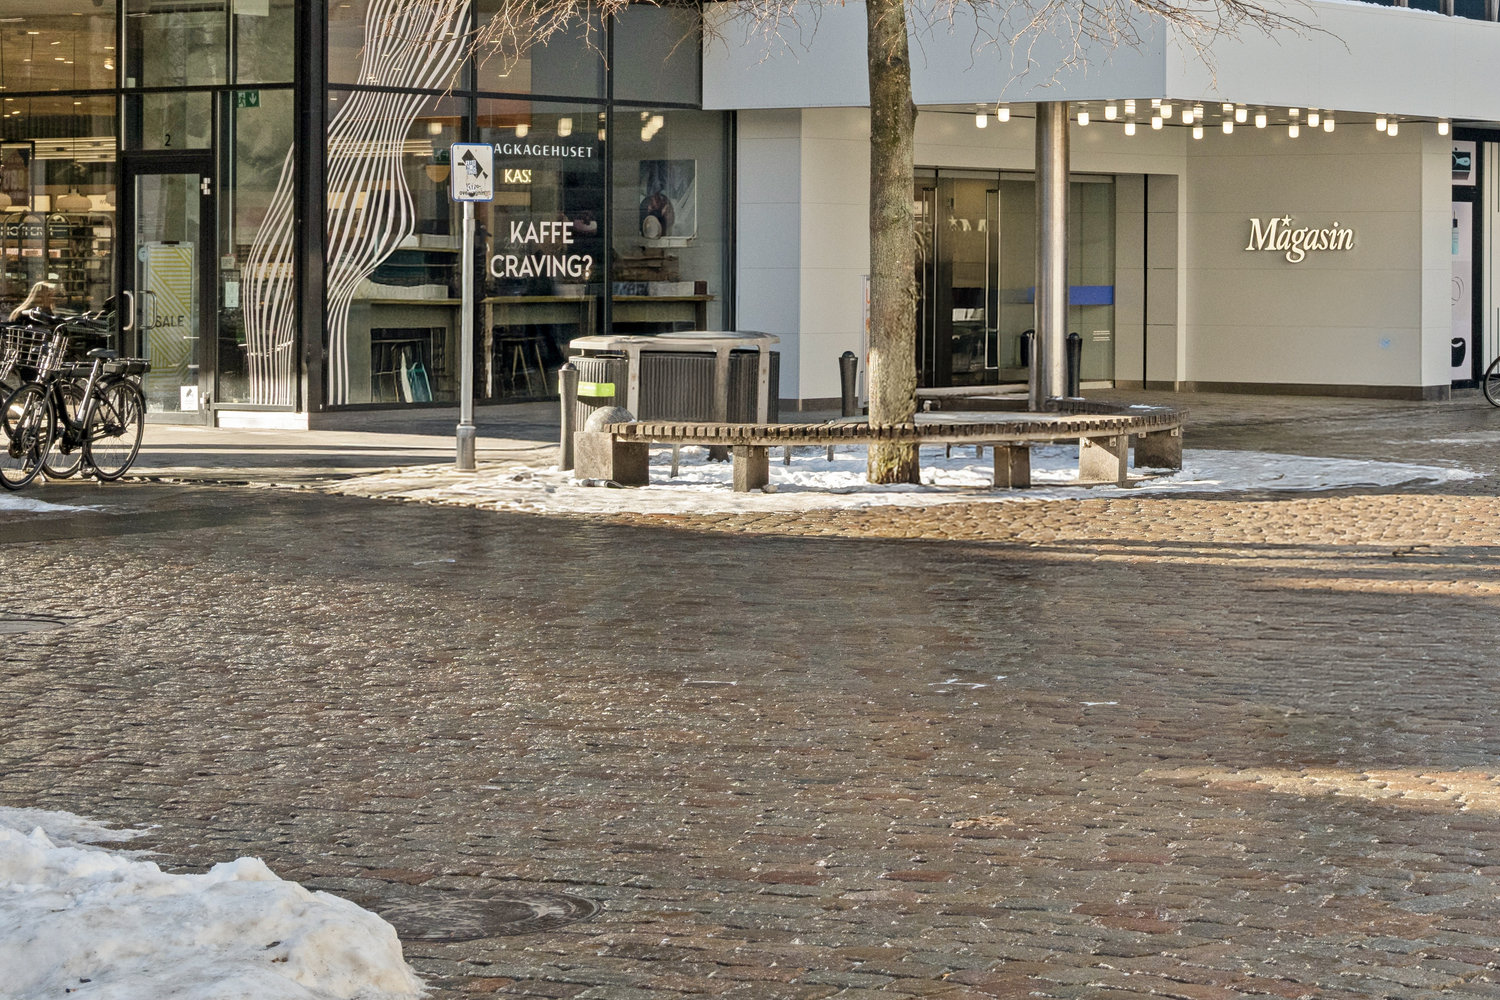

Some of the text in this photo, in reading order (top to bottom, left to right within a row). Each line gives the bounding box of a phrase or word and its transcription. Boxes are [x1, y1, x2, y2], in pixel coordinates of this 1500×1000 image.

[164, 134, 171, 147] 2
[494, 143, 593, 158] AGKAGEHUSET
[510, 221, 574, 244] KAFFE
[1245, 215, 1354, 263] Magasin
[490, 254, 593, 278] CRAVING?
[155, 314, 185, 328] SALE
